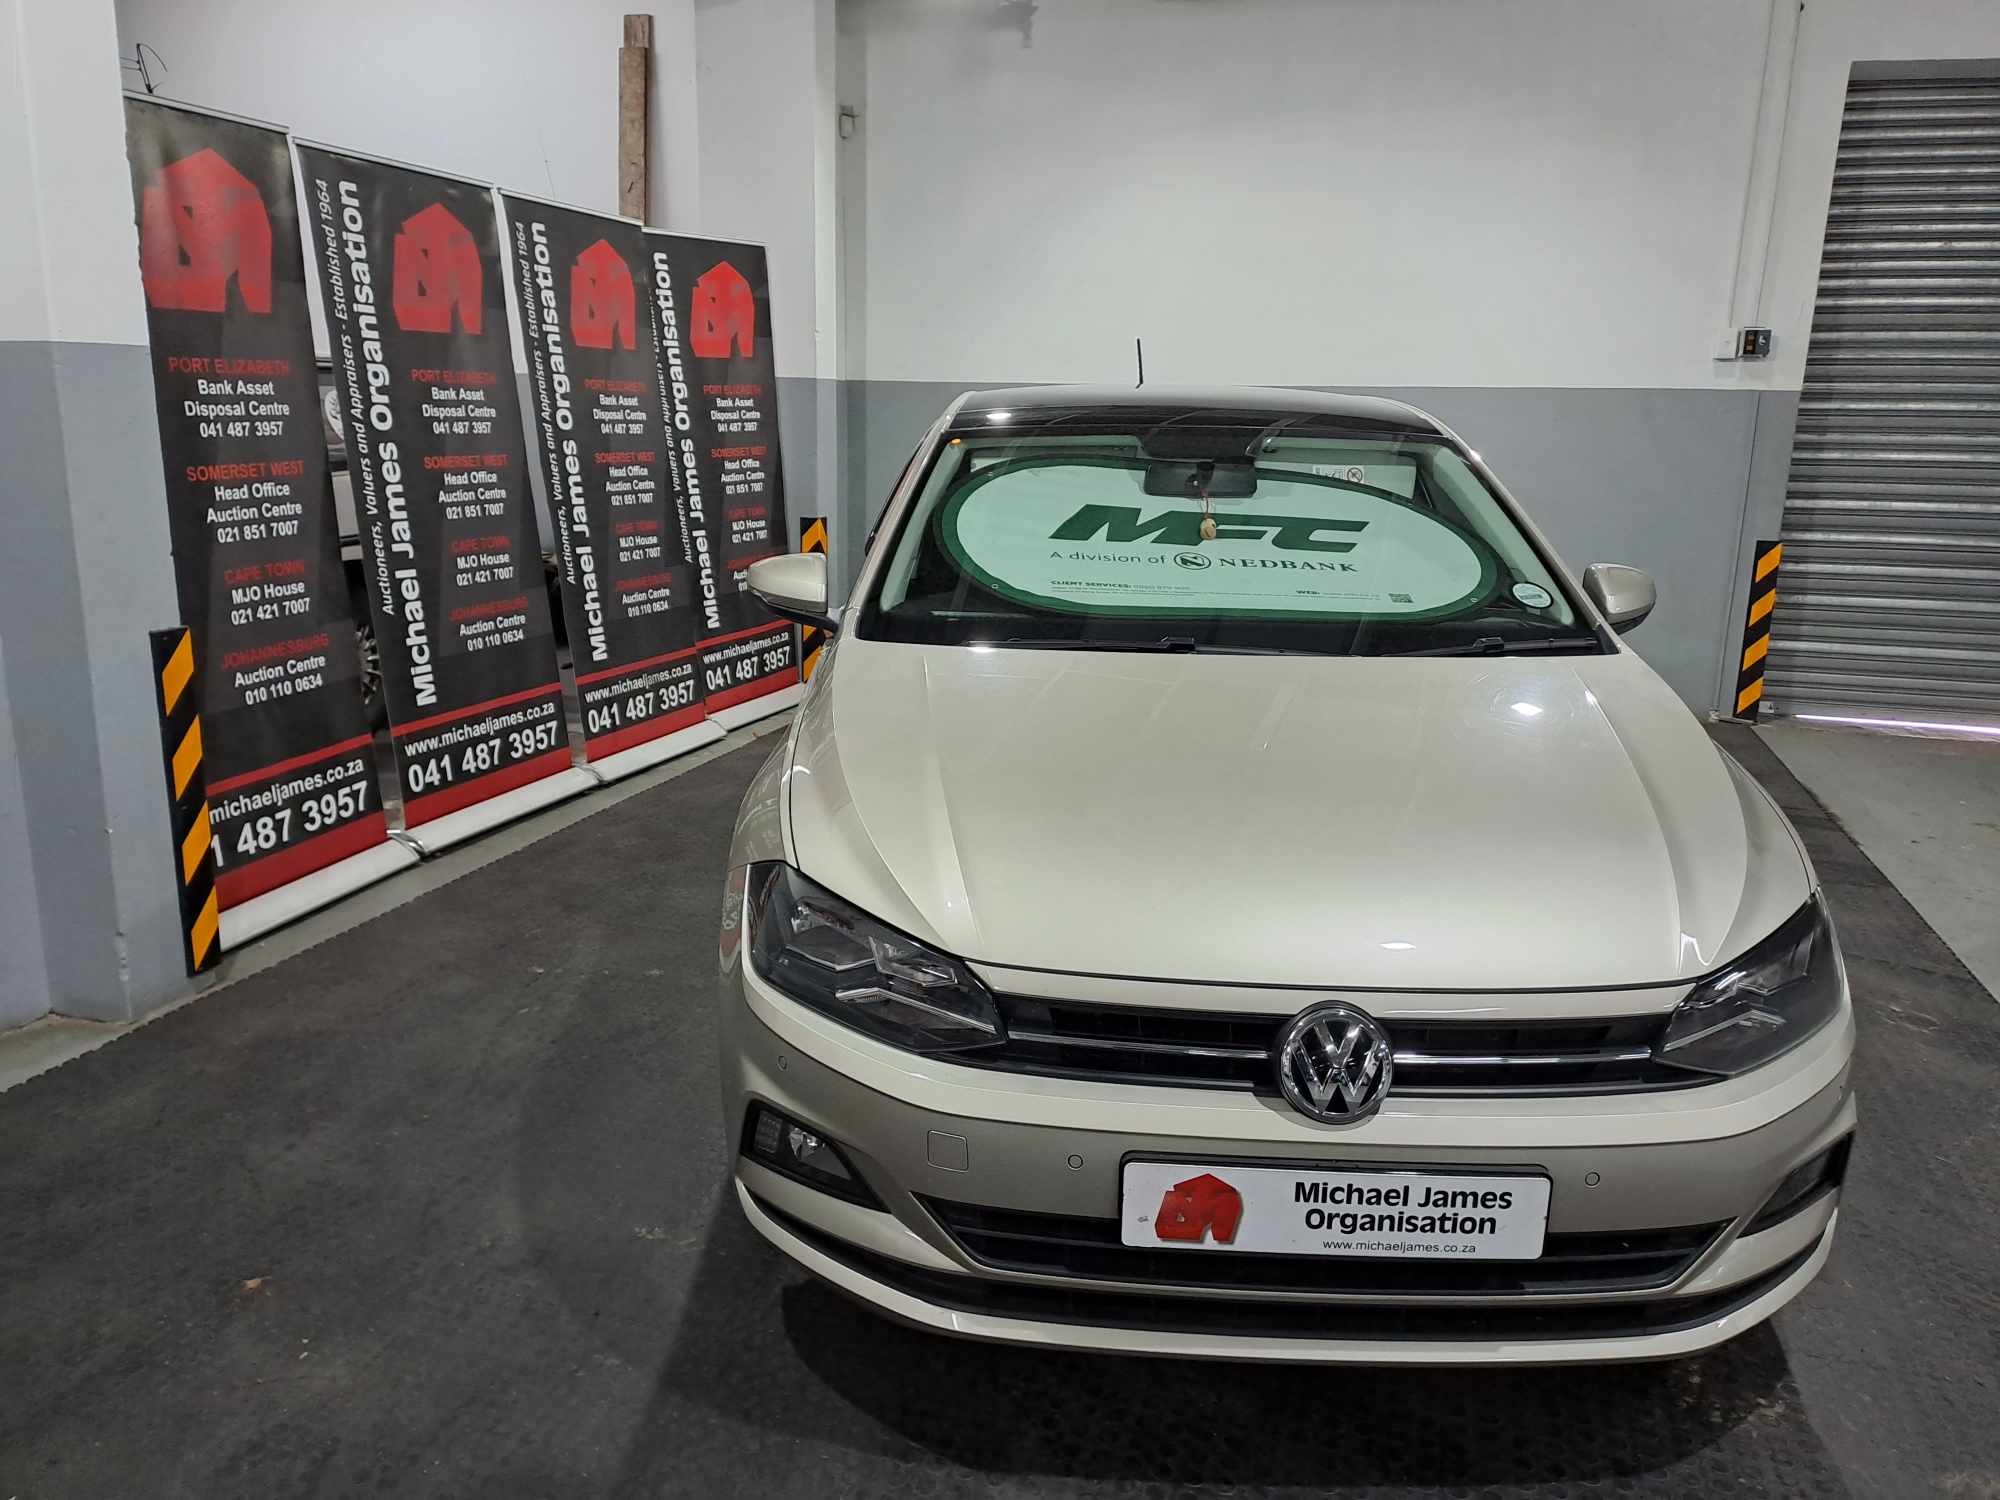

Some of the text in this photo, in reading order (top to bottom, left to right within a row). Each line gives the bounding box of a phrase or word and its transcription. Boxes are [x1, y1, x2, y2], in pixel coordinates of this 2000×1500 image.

[168, 357, 209, 373] PORT
[198, 380, 274, 396] Bank Asset
[316, 178, 394, 615] Auctioneers, Valuers and Appraisers Established 1964
[432, 387, 484, 401] Bank Asset
[184, 401, 289, 419] Disposal Centre
[515, 221, 576, 584] Auctioneers, Valuers and Appraisers Established 1964
[599, 394, 638, 406] Bank Asset
[422, 404, 496, 419] Disposal Centre
[593, 409, 646, 422] Disposal Centre
[200, 422, 284, 438] 041 487 3957
[432, 422, 492, 434] 041 487 3957
[186, 460, 304, 482] SOMERSET WEST
[444, 471, 497, 485] Head Office
[609, 465, 648, 477] Head Office
[681, 438, 704, 522] James
[214, 482, 290, 501] Head Office
[438, 487, 506, 503] Auction Centre
[563, 440, 590, 538] James
[606, 480, 655, 492] Auction Centre
[379, 442, 414, 559] James
[446, 503, 504, 520] 021 851 7007
[207, 502, 302, 523] Auction Centre
[218, 520, 298, 543] 021 851 7007
[1048, 504, 1370, 553] MFC
[620, 536, 658, 548] MJO House
[457, 553, 510, 569] MJO House
[1050, 551, 1358, 572] A division of NEDBANK
[456, 566, 514, 586] 021 421 7007
[692, 530, 720, 630] Michael
[232, 582, 304, 604] MJO House
[576, 546, 608, 661] Michael
[622, 588, 670, 605] Auction Centre
[231, 598, 310, 625] 021 421 7007
[460, 614, 526, 636] Auction Centre
[395, 569, 437, 706] Michael
[467, 629, 523, 651] 010 110 0634
[703, 632, 788, 664] www.michaeljames.co.za
[235, 656, 326, 688] Auction Centre
[706, 646, 790, 690] 041 487 3957
[245, 673, 322, 705] 010 110 0634
[585, 664, 692, 703] www.michaeljames.co.za
[588, 680, 694, 734] 041 487 3957
[404, 702, 554, 757] www.michaeljames.co.za
[408, 720, 558, 792] 041 487 3957
[237, 808, 291, 854] 487
[302, 780, 368, 832] 3957
[1294, 1182, 1512, 1210] Michael James
[1305, 1208, 1498, 1234] Organisation
[1322, 1240, 1476, 1254] www.michaeljames.co.za
